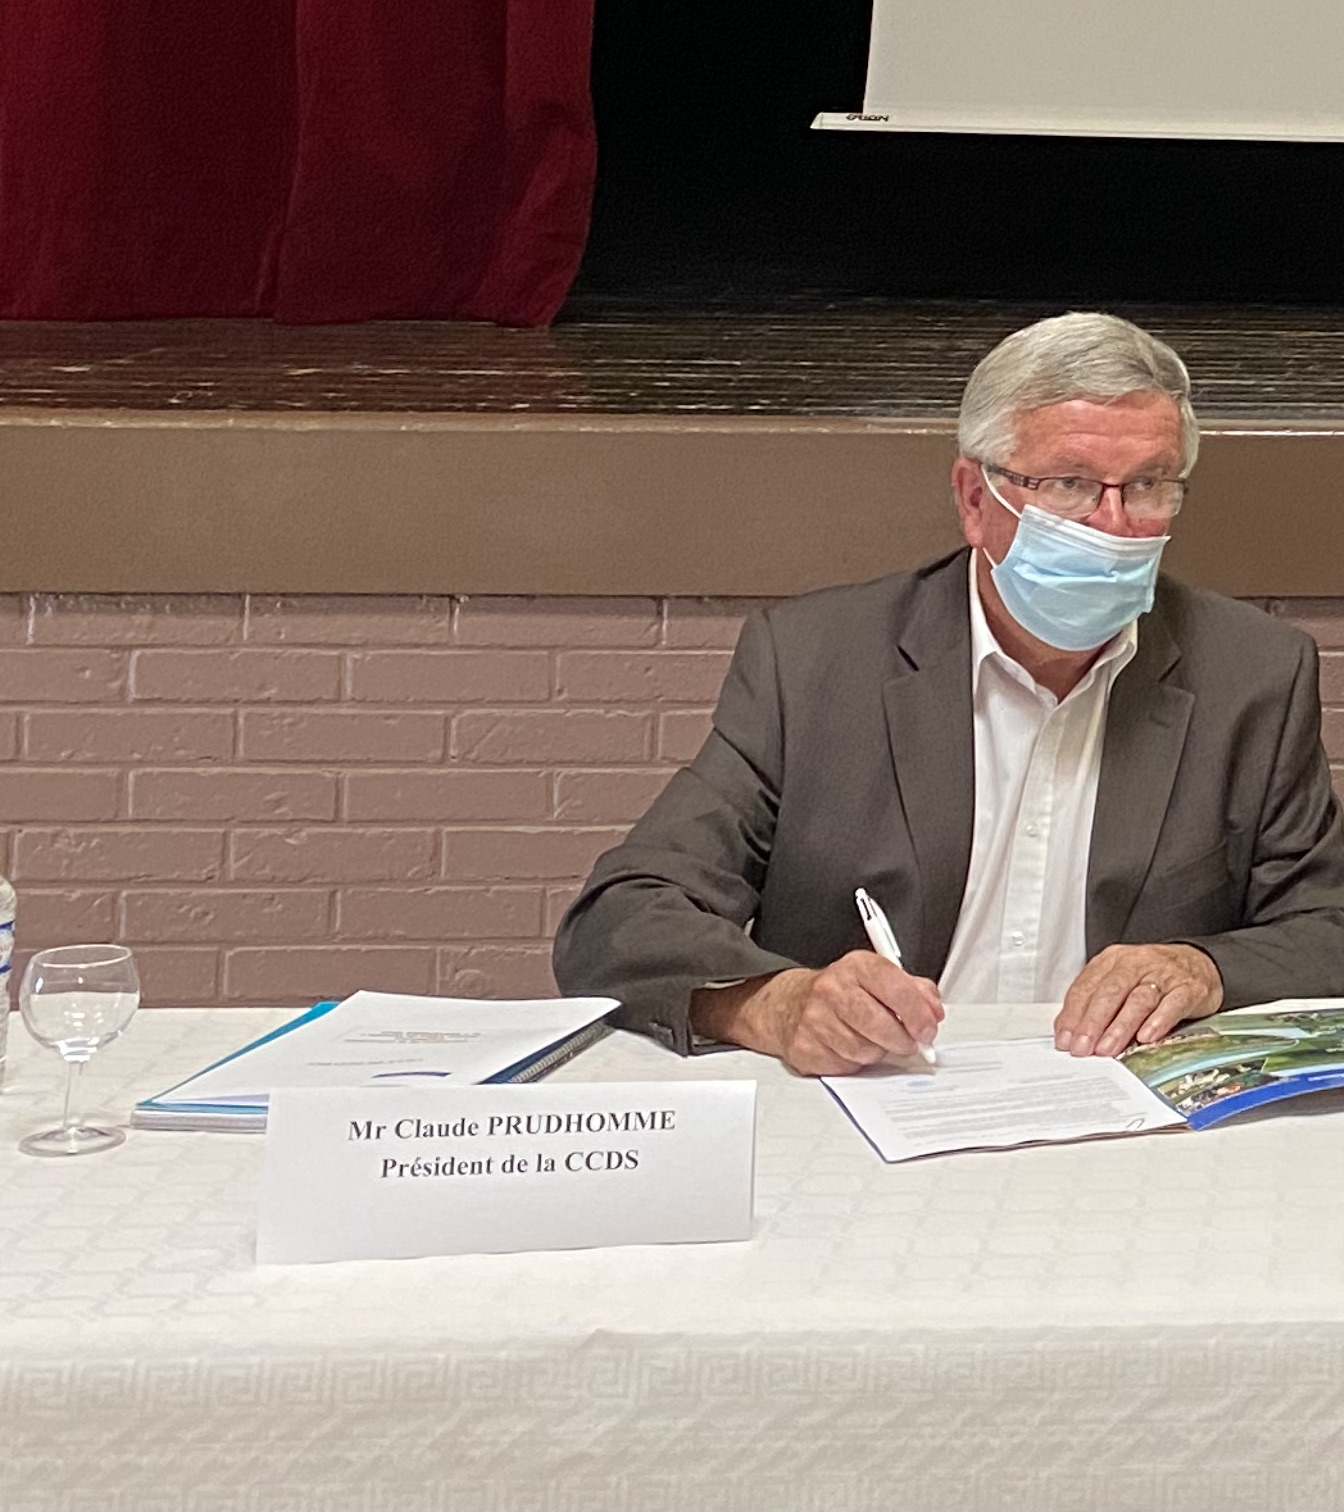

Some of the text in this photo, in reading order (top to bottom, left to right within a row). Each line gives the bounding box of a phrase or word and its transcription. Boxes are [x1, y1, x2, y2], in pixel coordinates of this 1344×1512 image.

[348, 1110, 677, 1141] Mr Claude PRUDHOMME
[381, 1150, 640, 1179] Président de la CCDS
